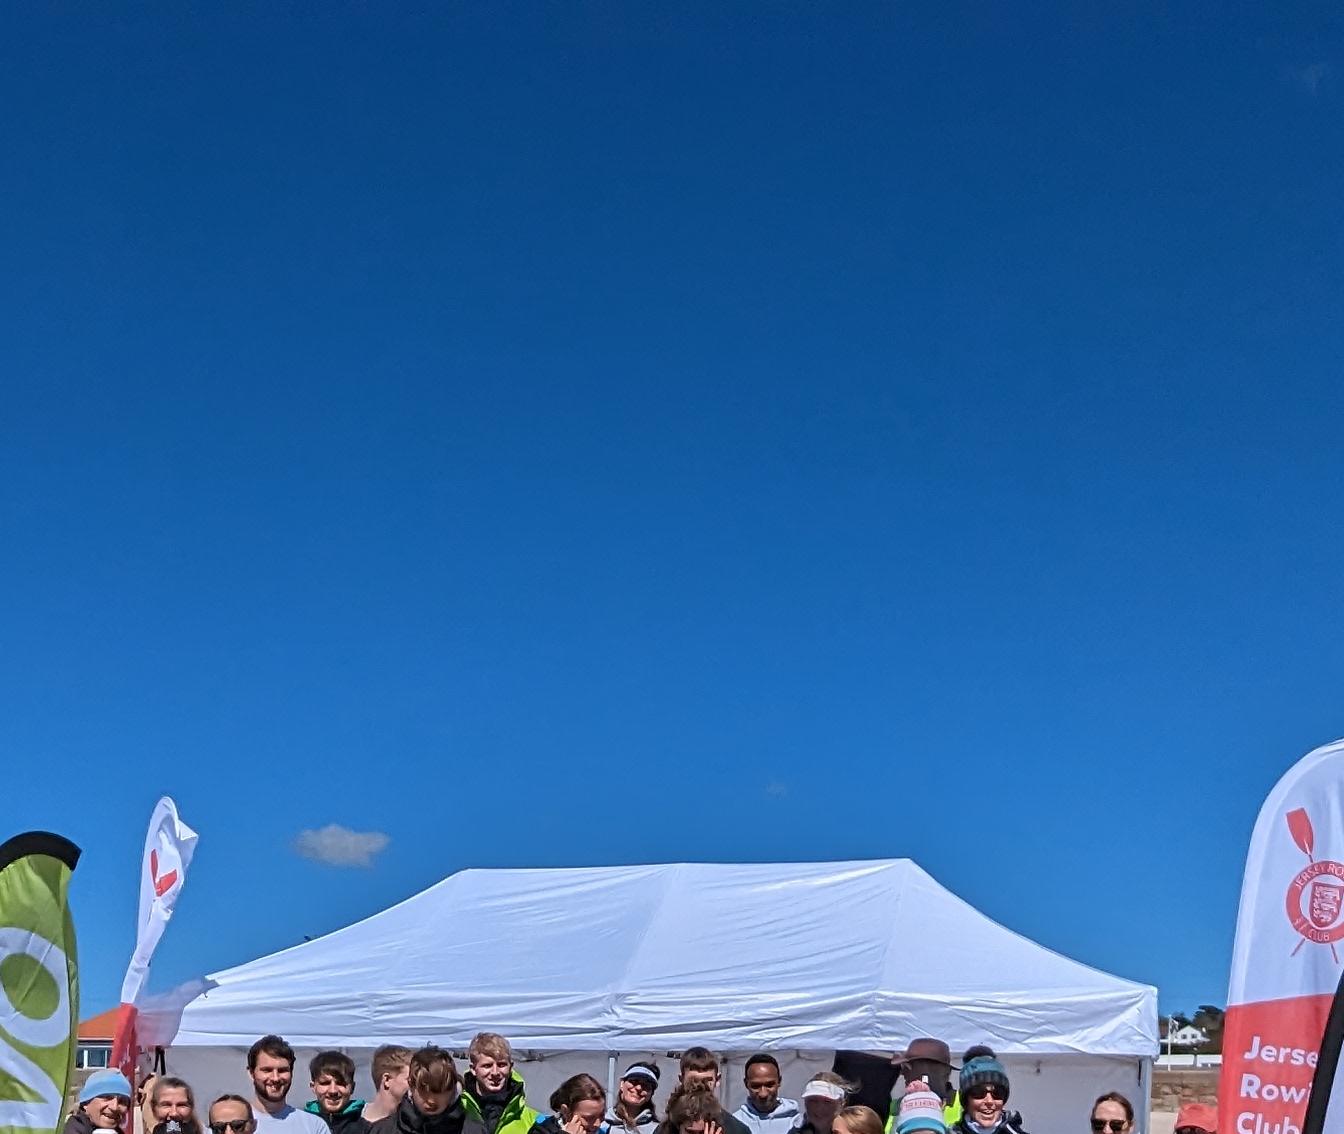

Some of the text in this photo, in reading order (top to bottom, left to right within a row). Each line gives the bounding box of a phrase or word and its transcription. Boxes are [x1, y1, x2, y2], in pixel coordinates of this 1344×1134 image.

[1307, 928, 1330, 942] CLUB
[1244, 1035, 1319, 1068] Jerse
[1240, 1073, 1313, 1103] Rowi
